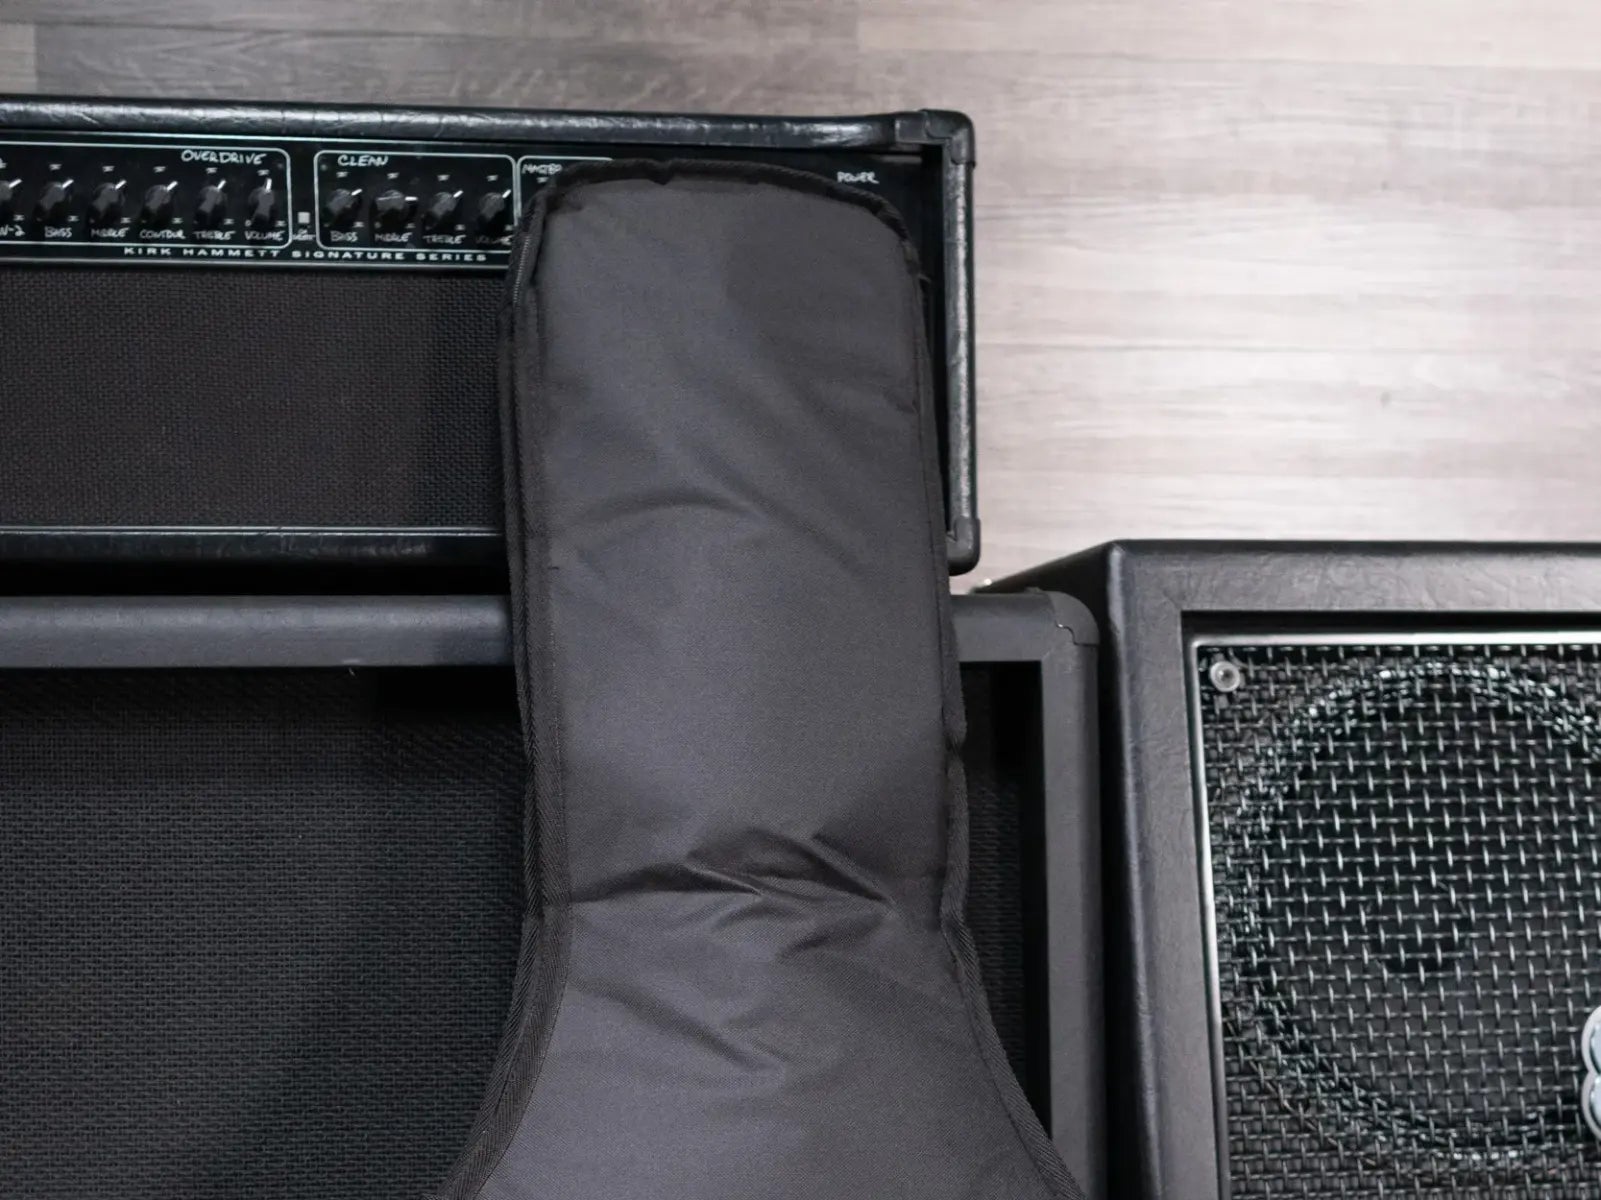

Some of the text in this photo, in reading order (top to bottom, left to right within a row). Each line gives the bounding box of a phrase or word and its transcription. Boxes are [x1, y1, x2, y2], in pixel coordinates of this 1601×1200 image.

[181, 149, 267, 164] OVERDRIVE
[337, 154, 389, 166] CLEAN
[243, 230, 286, 241] VOLUME
[123, 246, 487, 262] KIRK HAMMETT SIGNATURE SERIES
